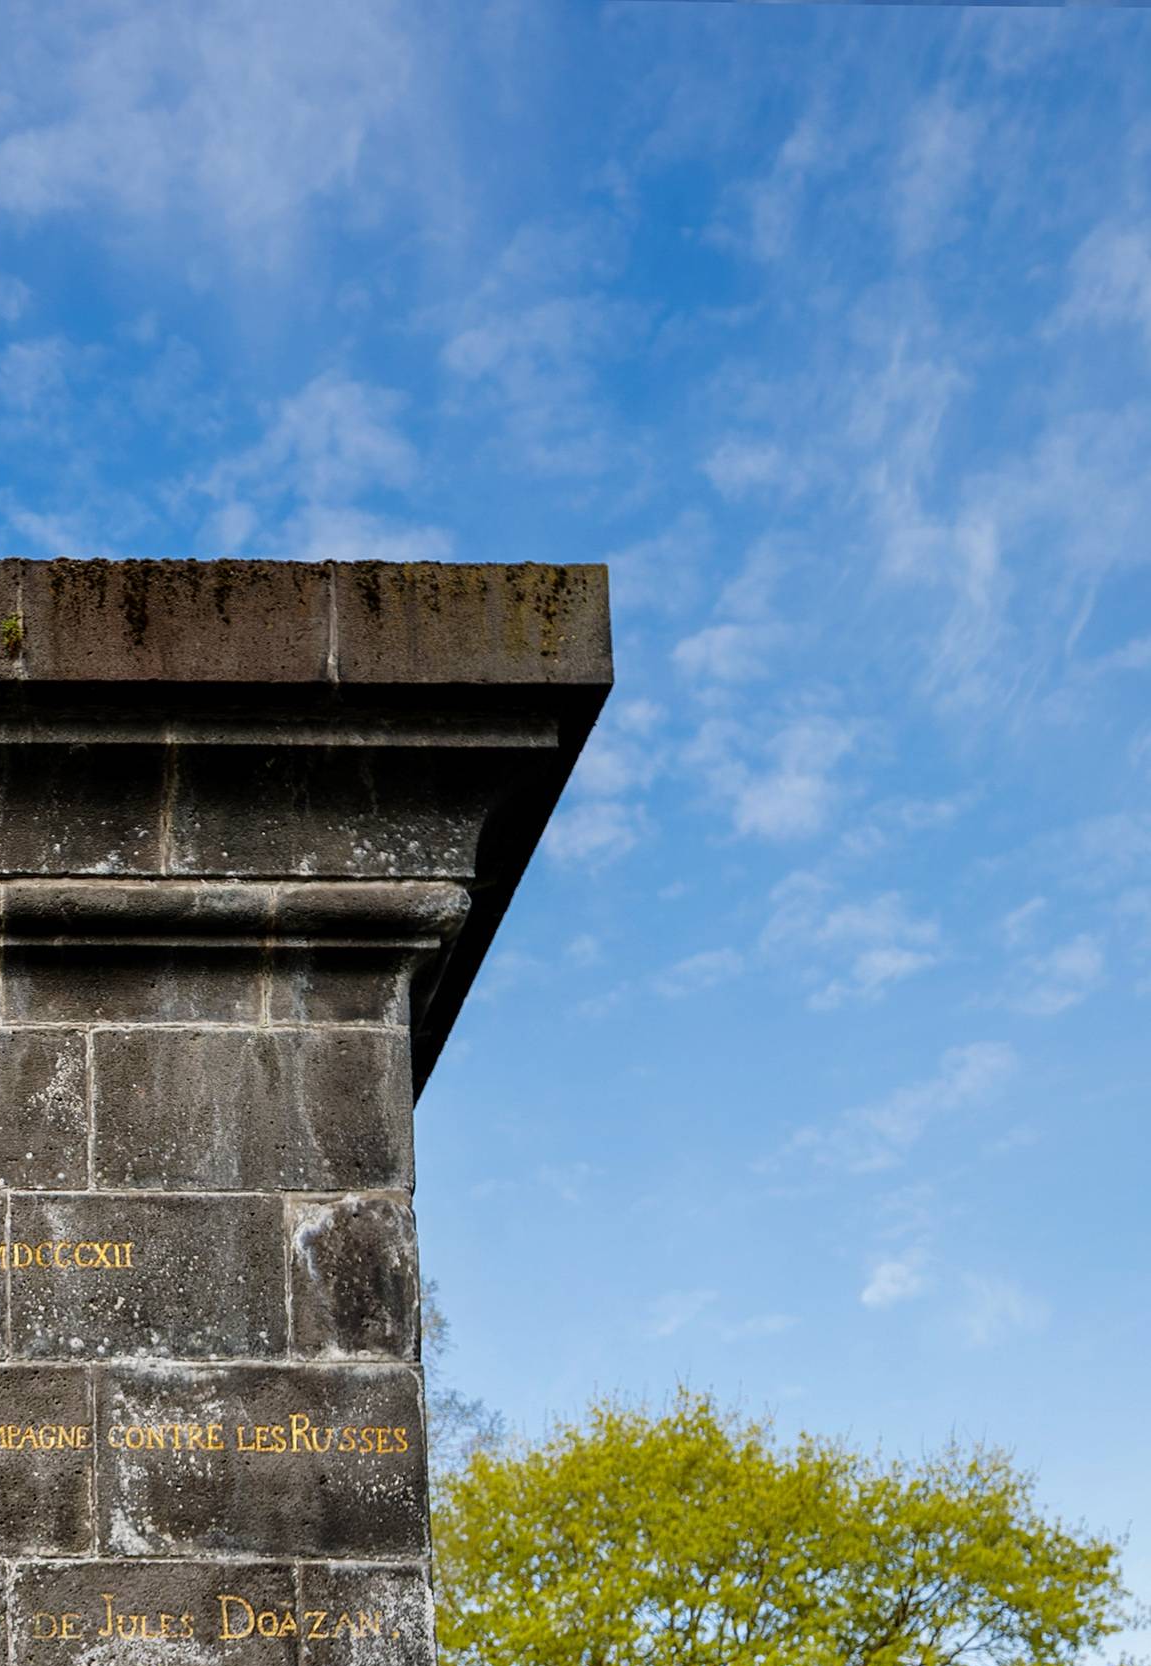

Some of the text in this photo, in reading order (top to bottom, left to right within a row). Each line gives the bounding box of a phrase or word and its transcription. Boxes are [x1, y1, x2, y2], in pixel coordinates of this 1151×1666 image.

[108, 1424, 225, 1452] CONTRE
[237, 1425, 287, 1453] LES
[33, 1613, 82, 1640] DE
[98, 1593, 195, 1640] JULES
